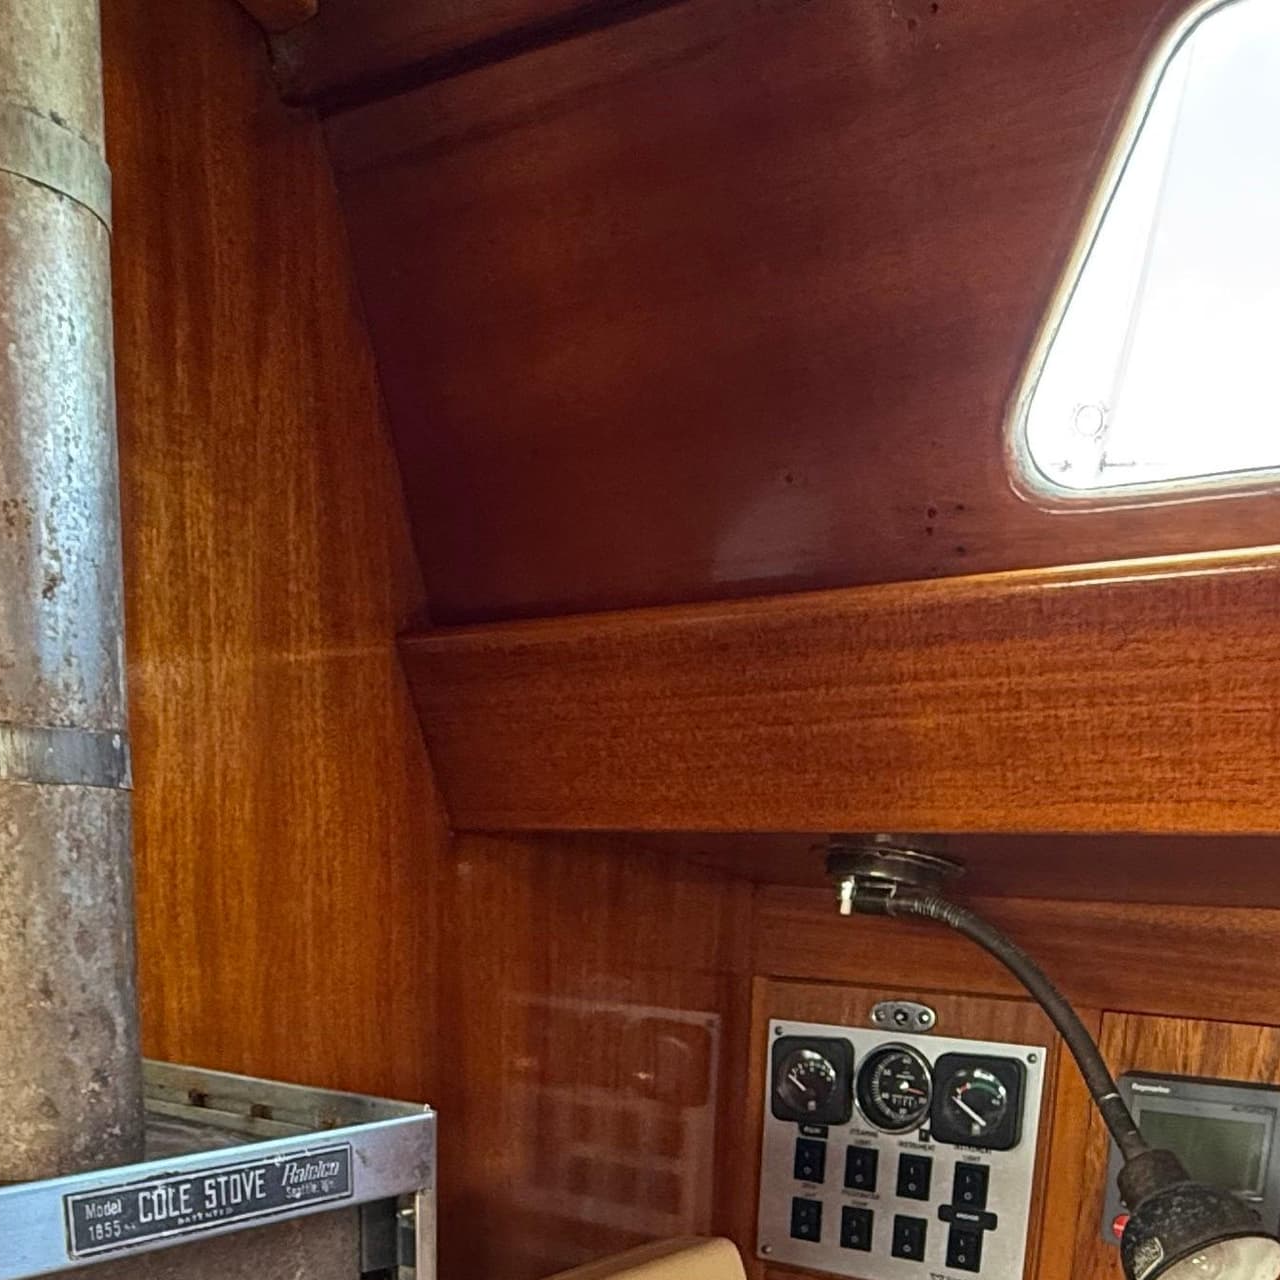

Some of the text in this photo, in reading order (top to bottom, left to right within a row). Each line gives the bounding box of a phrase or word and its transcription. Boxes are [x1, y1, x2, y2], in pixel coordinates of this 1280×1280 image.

[138, 1168, 267, 1224] COLE STOVE
[85, 1199, 123, 1220] Model
[89, 1220, 121, 1241] 1855
